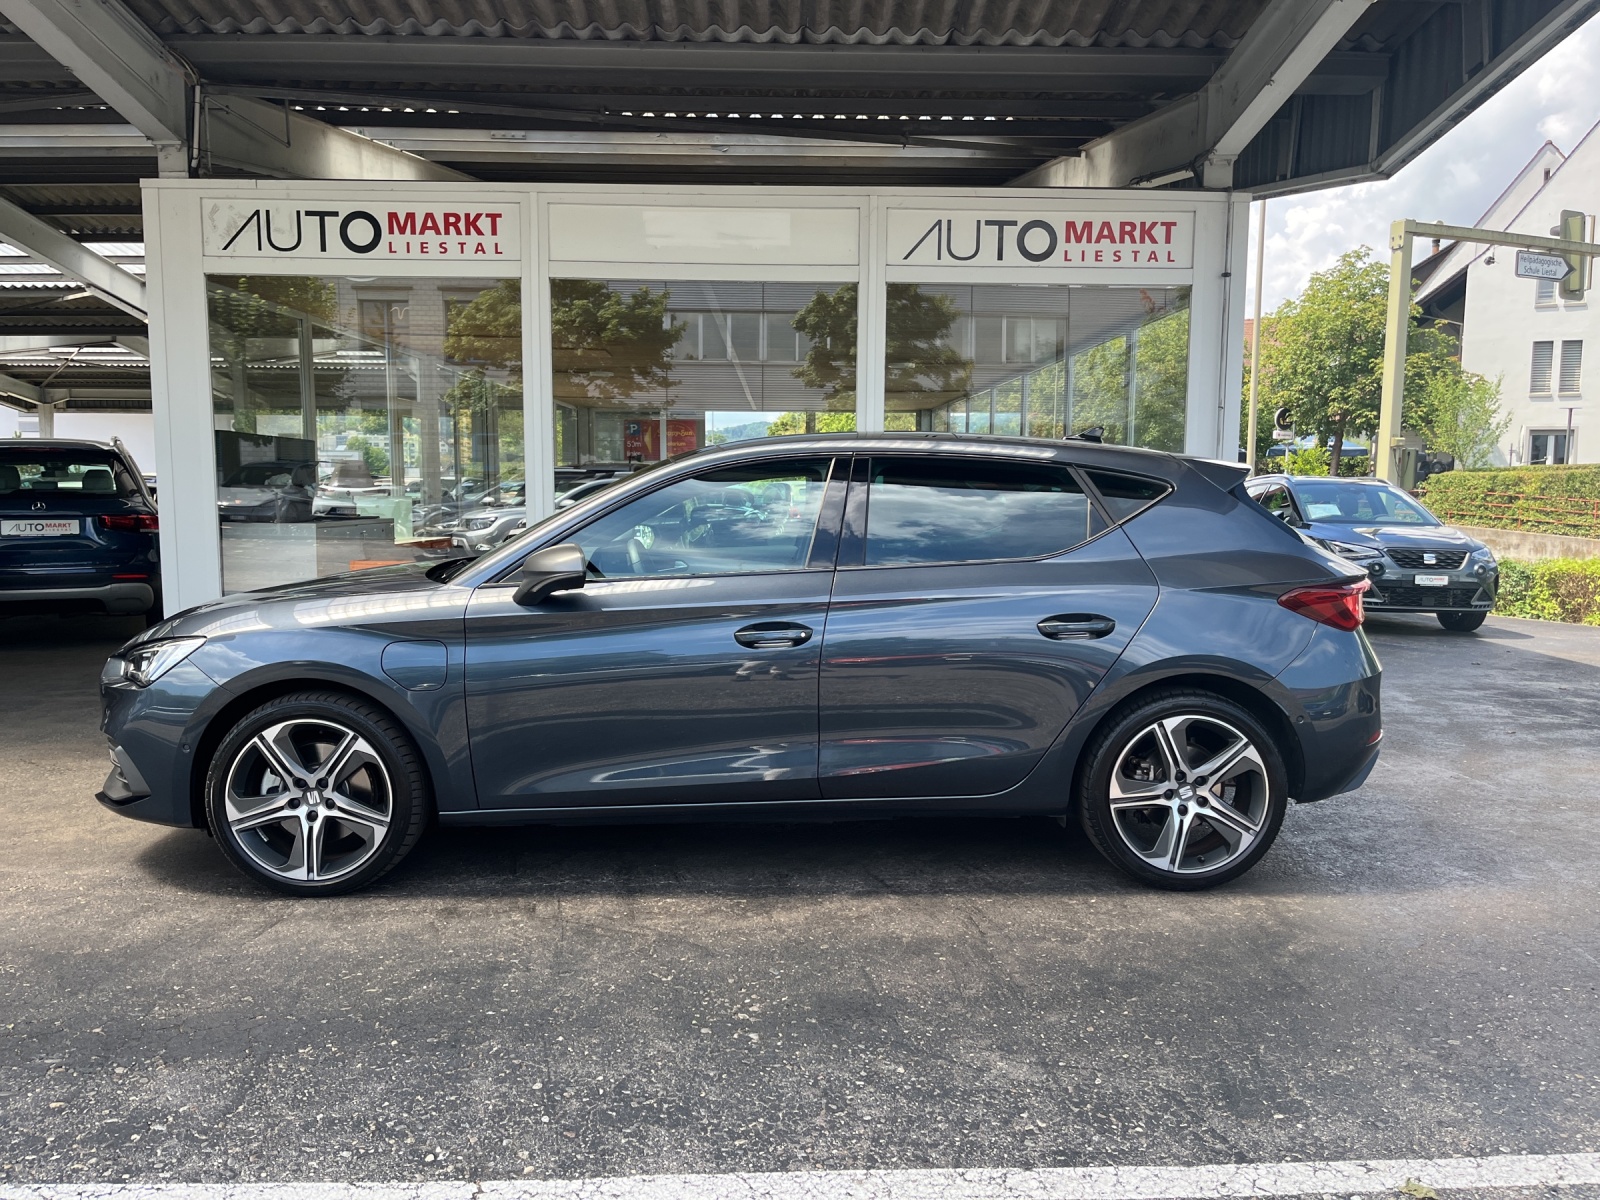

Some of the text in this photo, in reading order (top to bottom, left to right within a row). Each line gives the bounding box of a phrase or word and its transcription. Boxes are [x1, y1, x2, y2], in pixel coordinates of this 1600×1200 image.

[221, 209, 503, 254] AUTO MARKT
[902, 219, 1178, 263] AUTO MARKT
[388, 241, 503, 255] LIESTAL
[1064, 250, 1176, 263] LIESTAL
[1520, 254, 1562, 267] Heilpädagogische
[1523, 265, 1558, 277] Schule Liestal
[630, 424, 638, 434] P
[9, 523, 45, 532] AUTO
